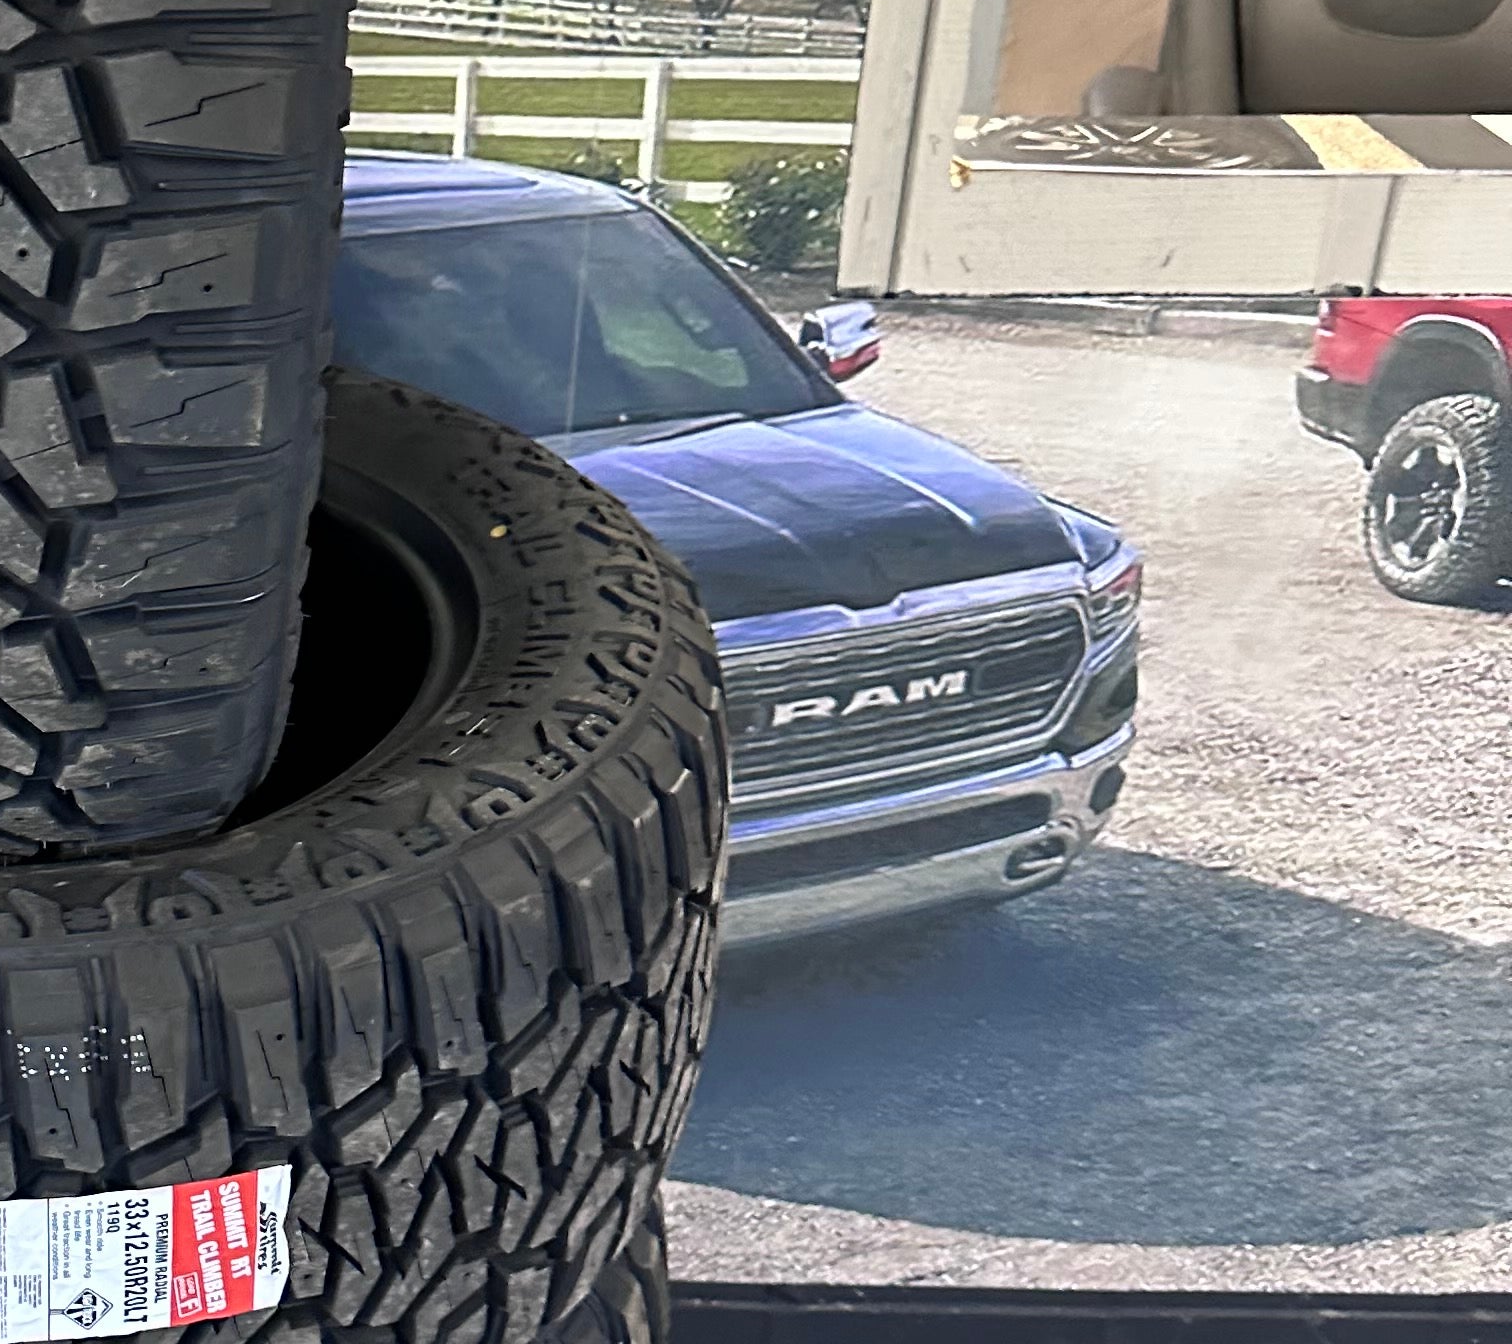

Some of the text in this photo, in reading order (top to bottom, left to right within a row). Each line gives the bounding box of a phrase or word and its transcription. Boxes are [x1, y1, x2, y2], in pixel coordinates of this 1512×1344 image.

[771, 670, 971, 727] RAM
[105, 1202, 120, 1234] 119Q
[123, 1198, 150, 1323] 33x12.50R20LT
[154, 1213, 169, 1304] PREMIUM RADIAL
[190, 1189, 228, 1314] TRAIL CLIMBER
[218, 1181, 252, 1280] SUMMIT RT
